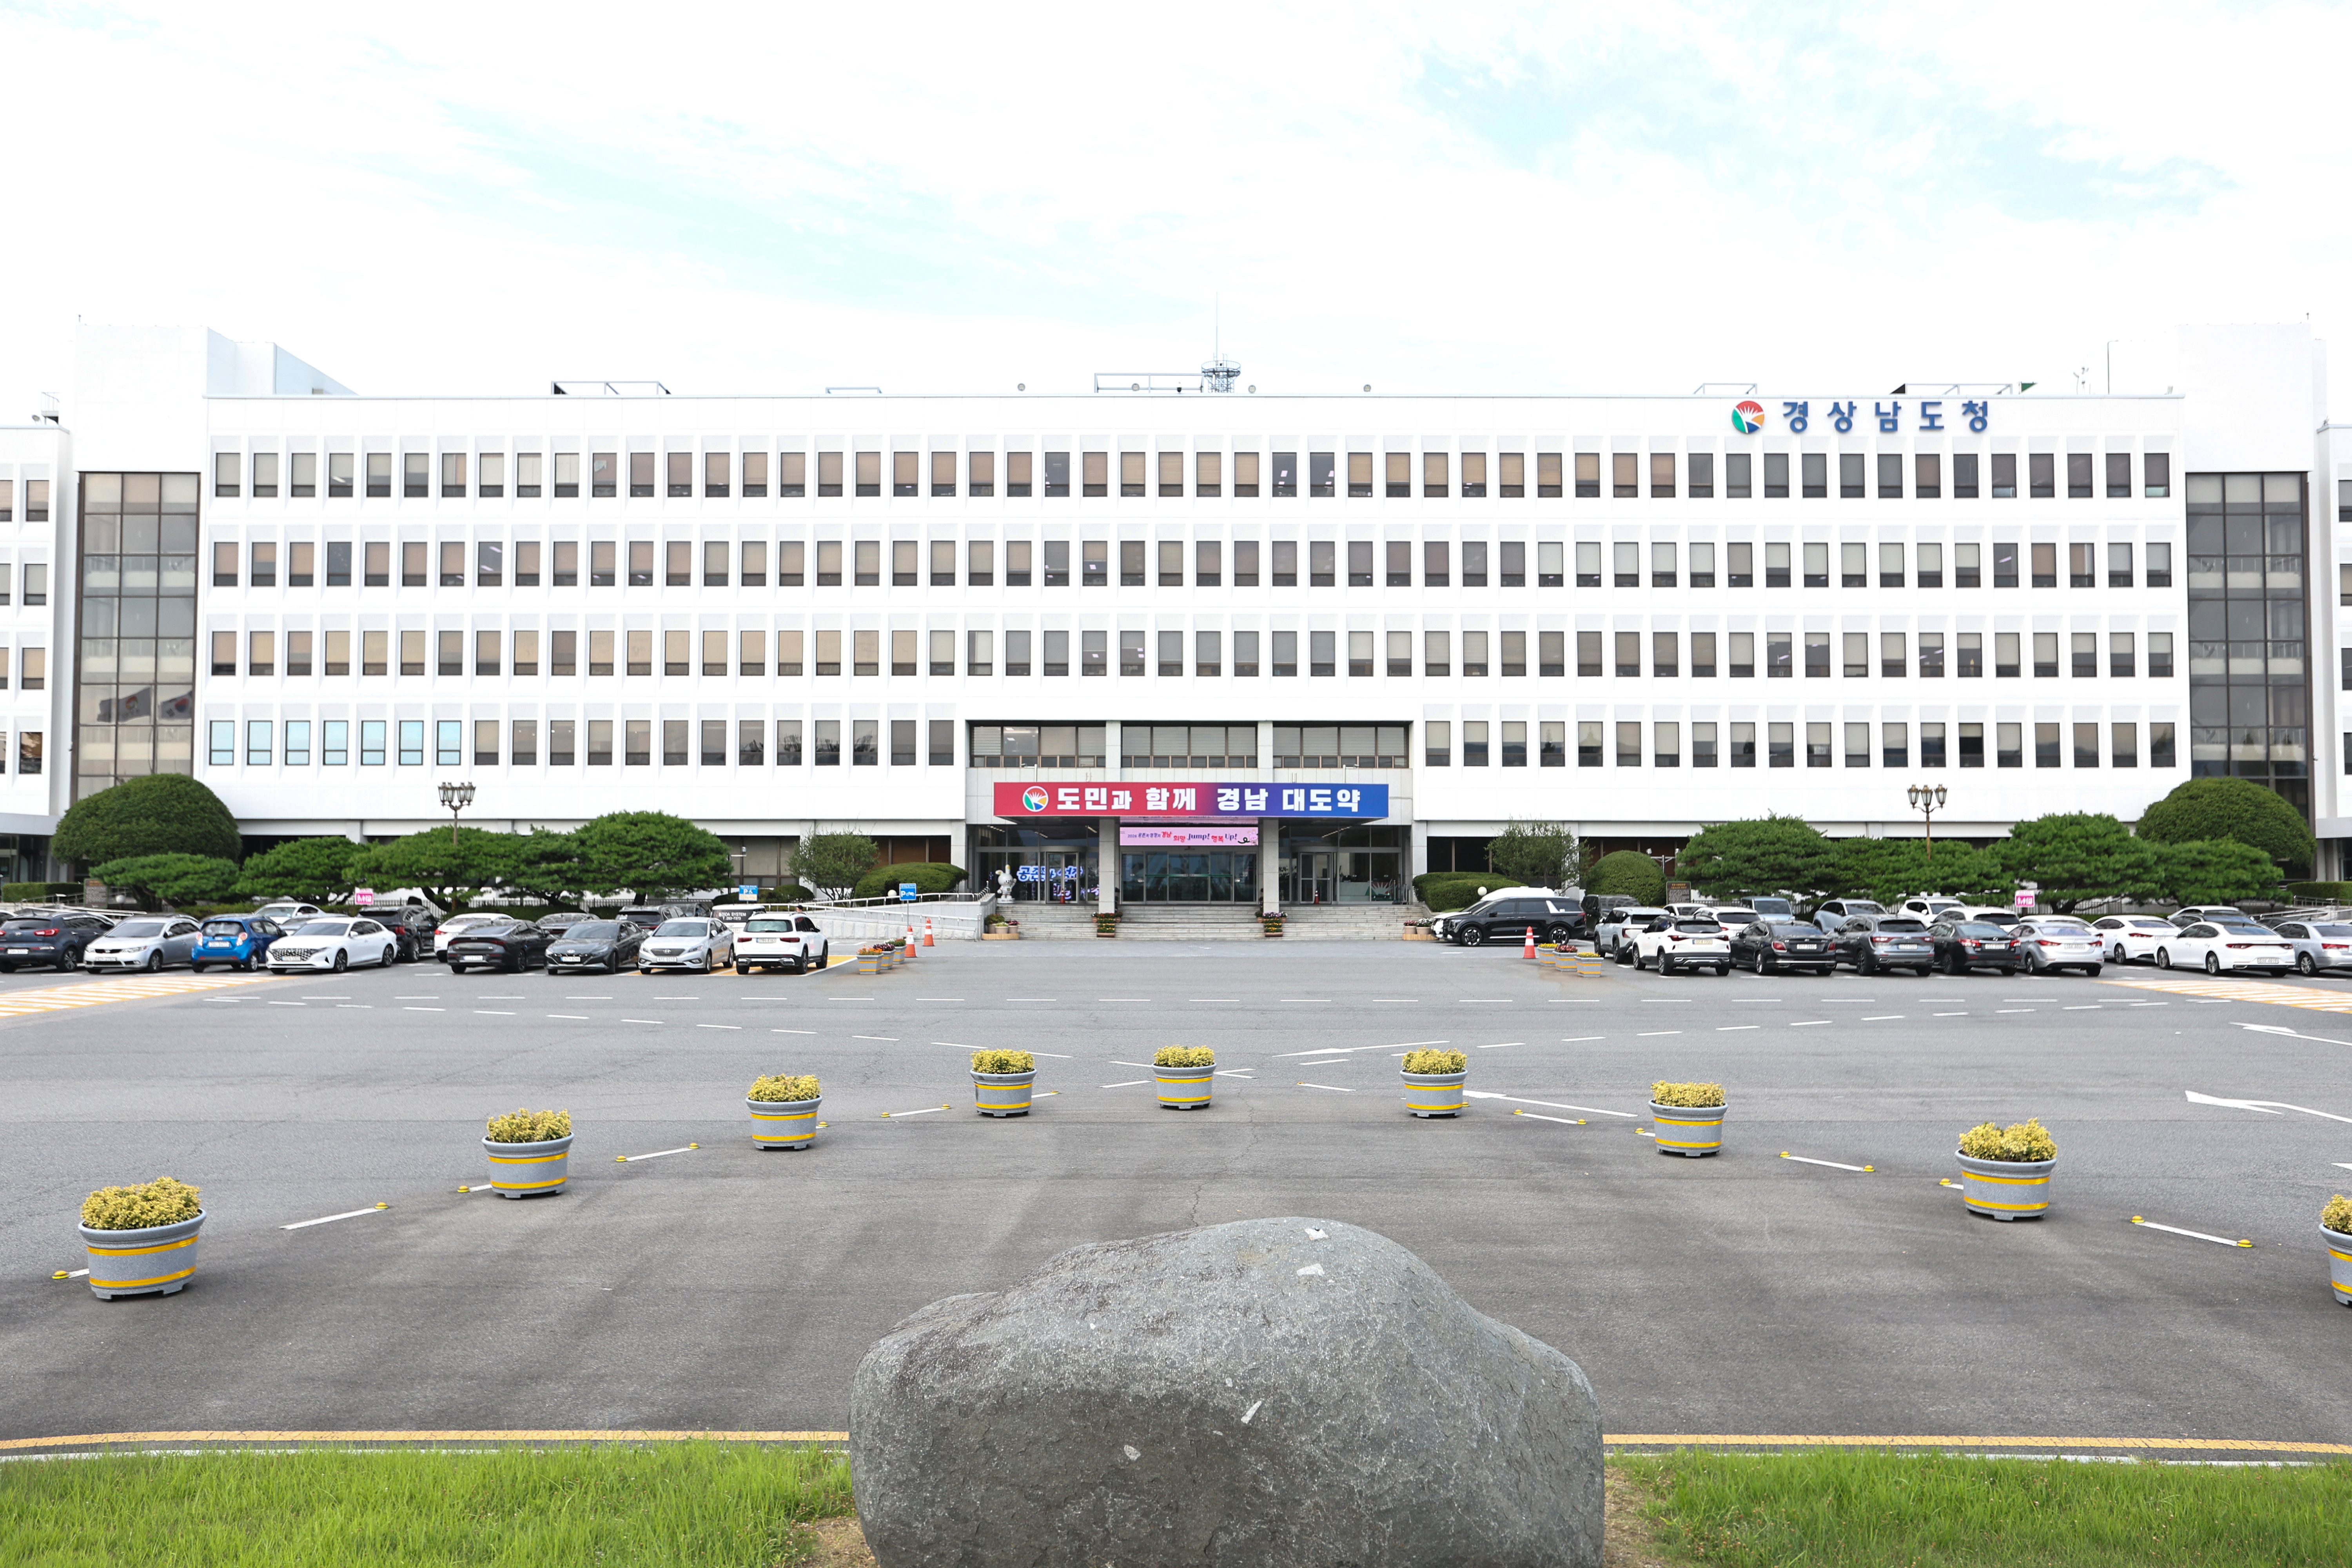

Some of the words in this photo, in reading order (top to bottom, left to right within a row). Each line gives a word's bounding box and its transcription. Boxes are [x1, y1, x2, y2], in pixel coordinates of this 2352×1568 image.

[1783, 400, 1987, 432] 경상남도청
[1057, 788, 1132, 810] 도민과
[1146, 787, 1196, 810] 함께
[1217, 788, 1268, 811] 경남
[1282, 788, 1360, 812] 대도약
